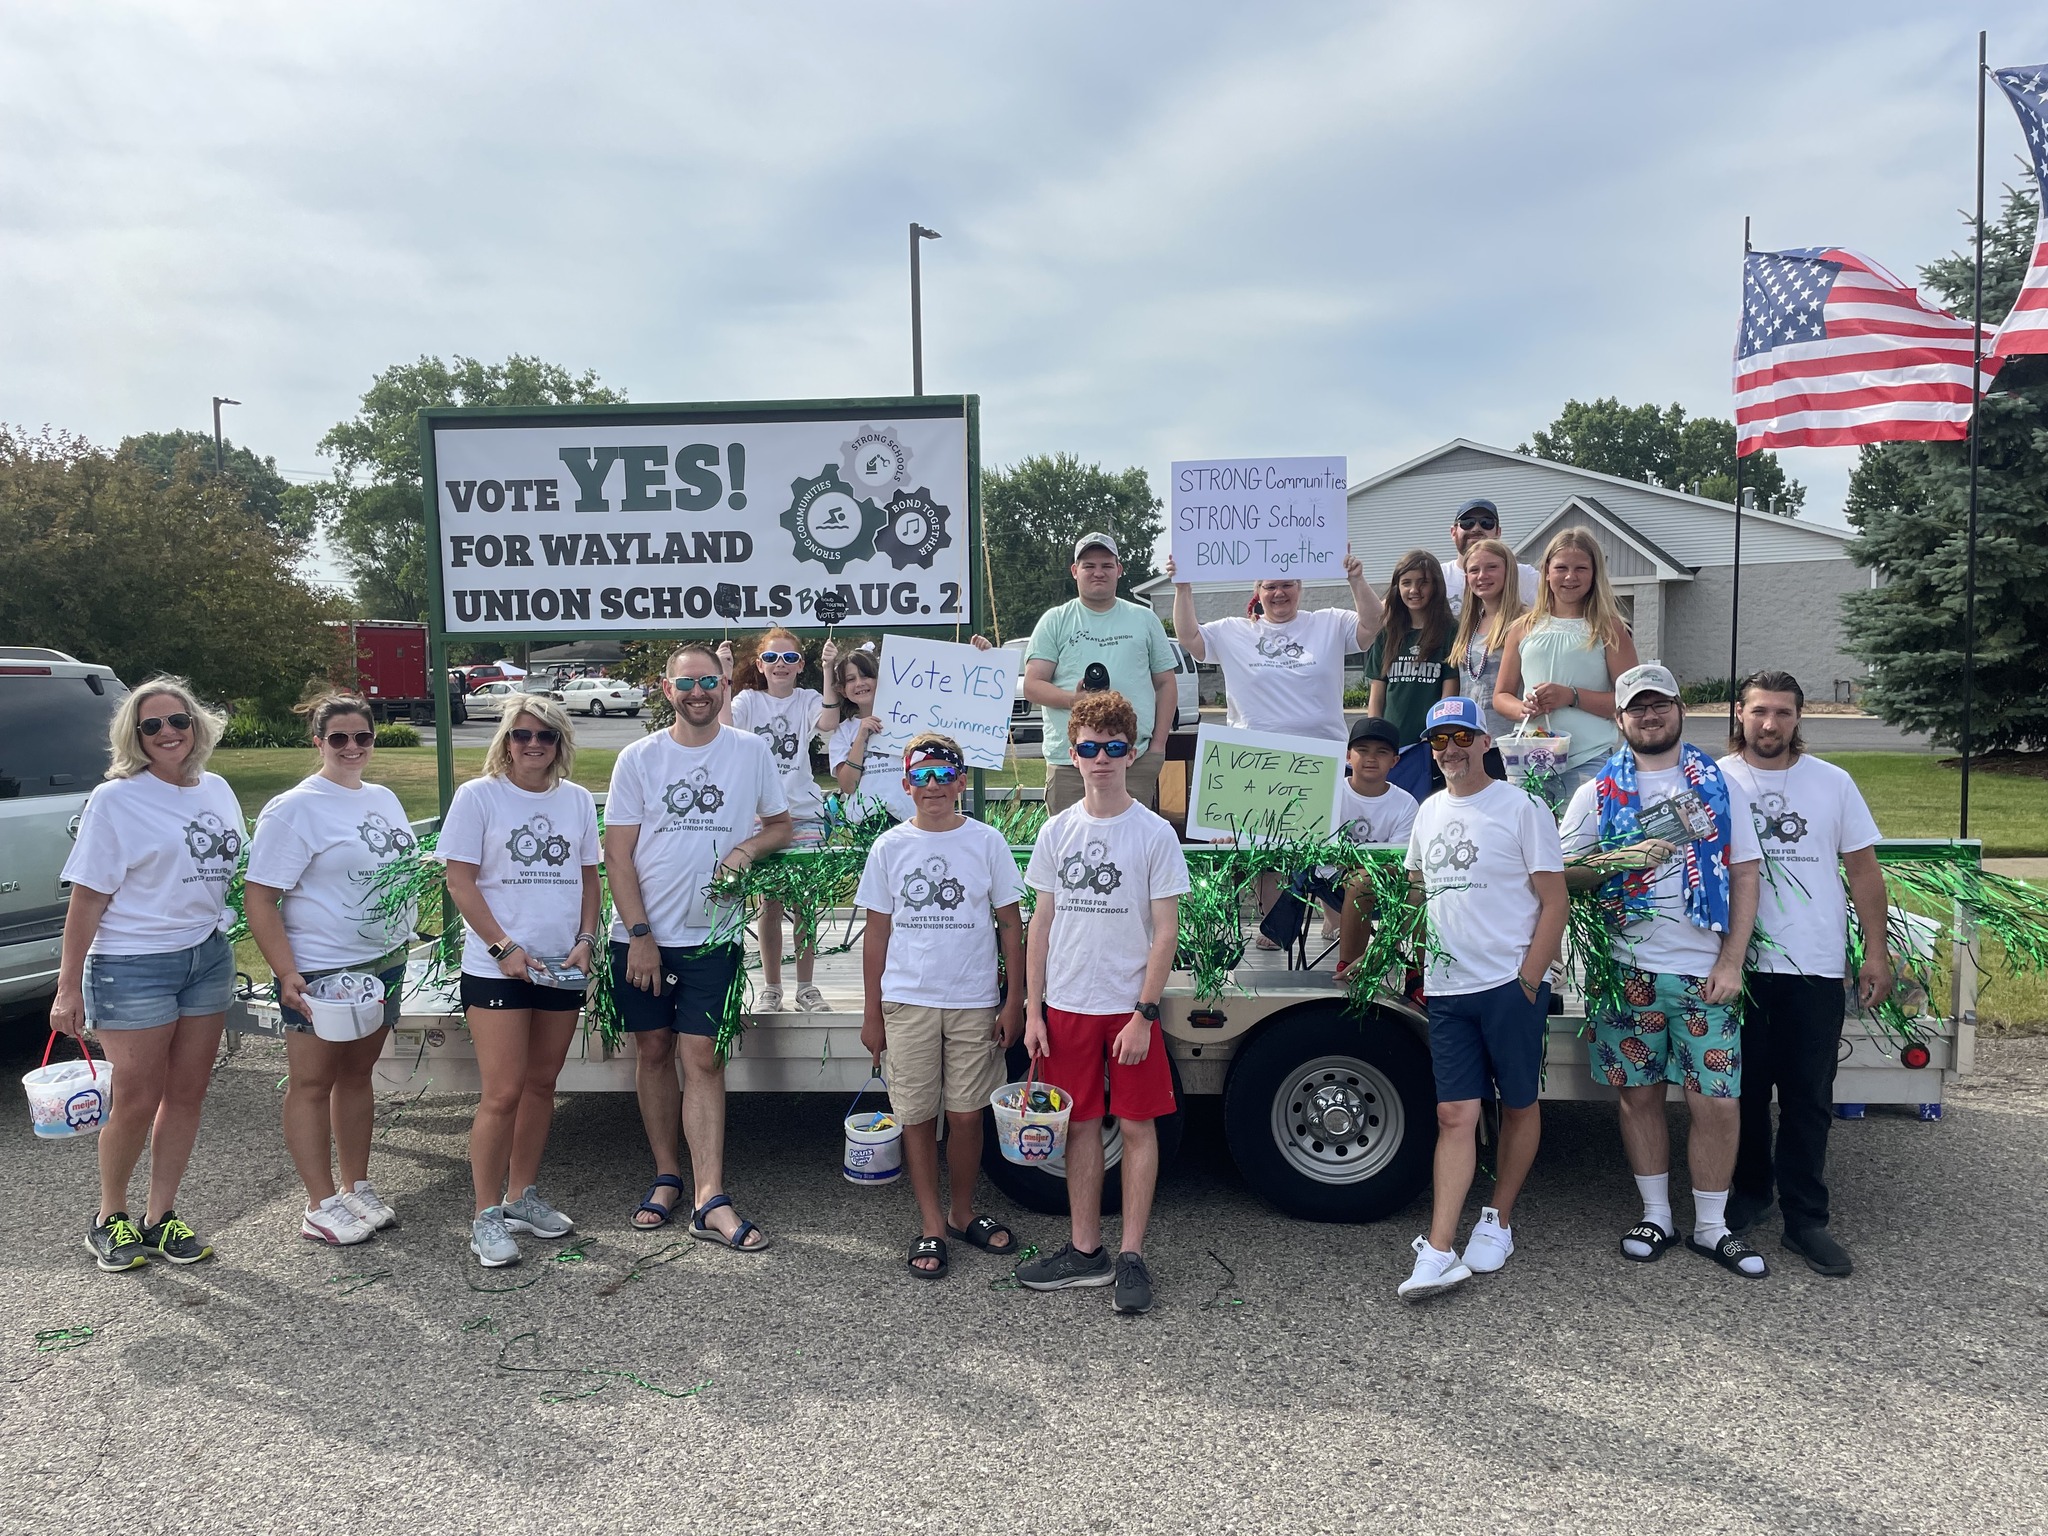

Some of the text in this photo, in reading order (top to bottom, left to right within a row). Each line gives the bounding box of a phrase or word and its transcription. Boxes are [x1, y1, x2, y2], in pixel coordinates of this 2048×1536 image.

[851, 433, 905, 482] STRONG SCHOOLS
[445, 442, 748, 512] VOTE YES!
[1179, 466, 1347, 492] STRONG Communities
[796, 480, 841, 560] STRONG COMMUNITIES
[891, 499, 940, 556] BOND TOGETHER
[1179, 504, 1326, 531] STRONG Schools
[450, 530, 754, 568] FOR WAYLAND
[1197, 539, 1334, 572] BOND Together
[452, 587, 592, 622] UNION
[600, 584, 793, 620] SCHOLS
[835, 581, 931, 616] AUG.
[939, 581, 963, 614] 2
[817, 611, 835, 619] VOTE
[891, 656, 1006, 700] Vote YES
[888, 700, 1011, 739] for Swimmers!
[1205, 744, 1324, 775] A VOTE YES
[1208, 773, 1313, 800] IS A VOTE
[1205, 802, 1235, 822] for
[72, 1099, 97, 1111] meijer
[849, 1148, 874, 1158] Dean's
[1024, 1133, 1050, 1143] meijer
